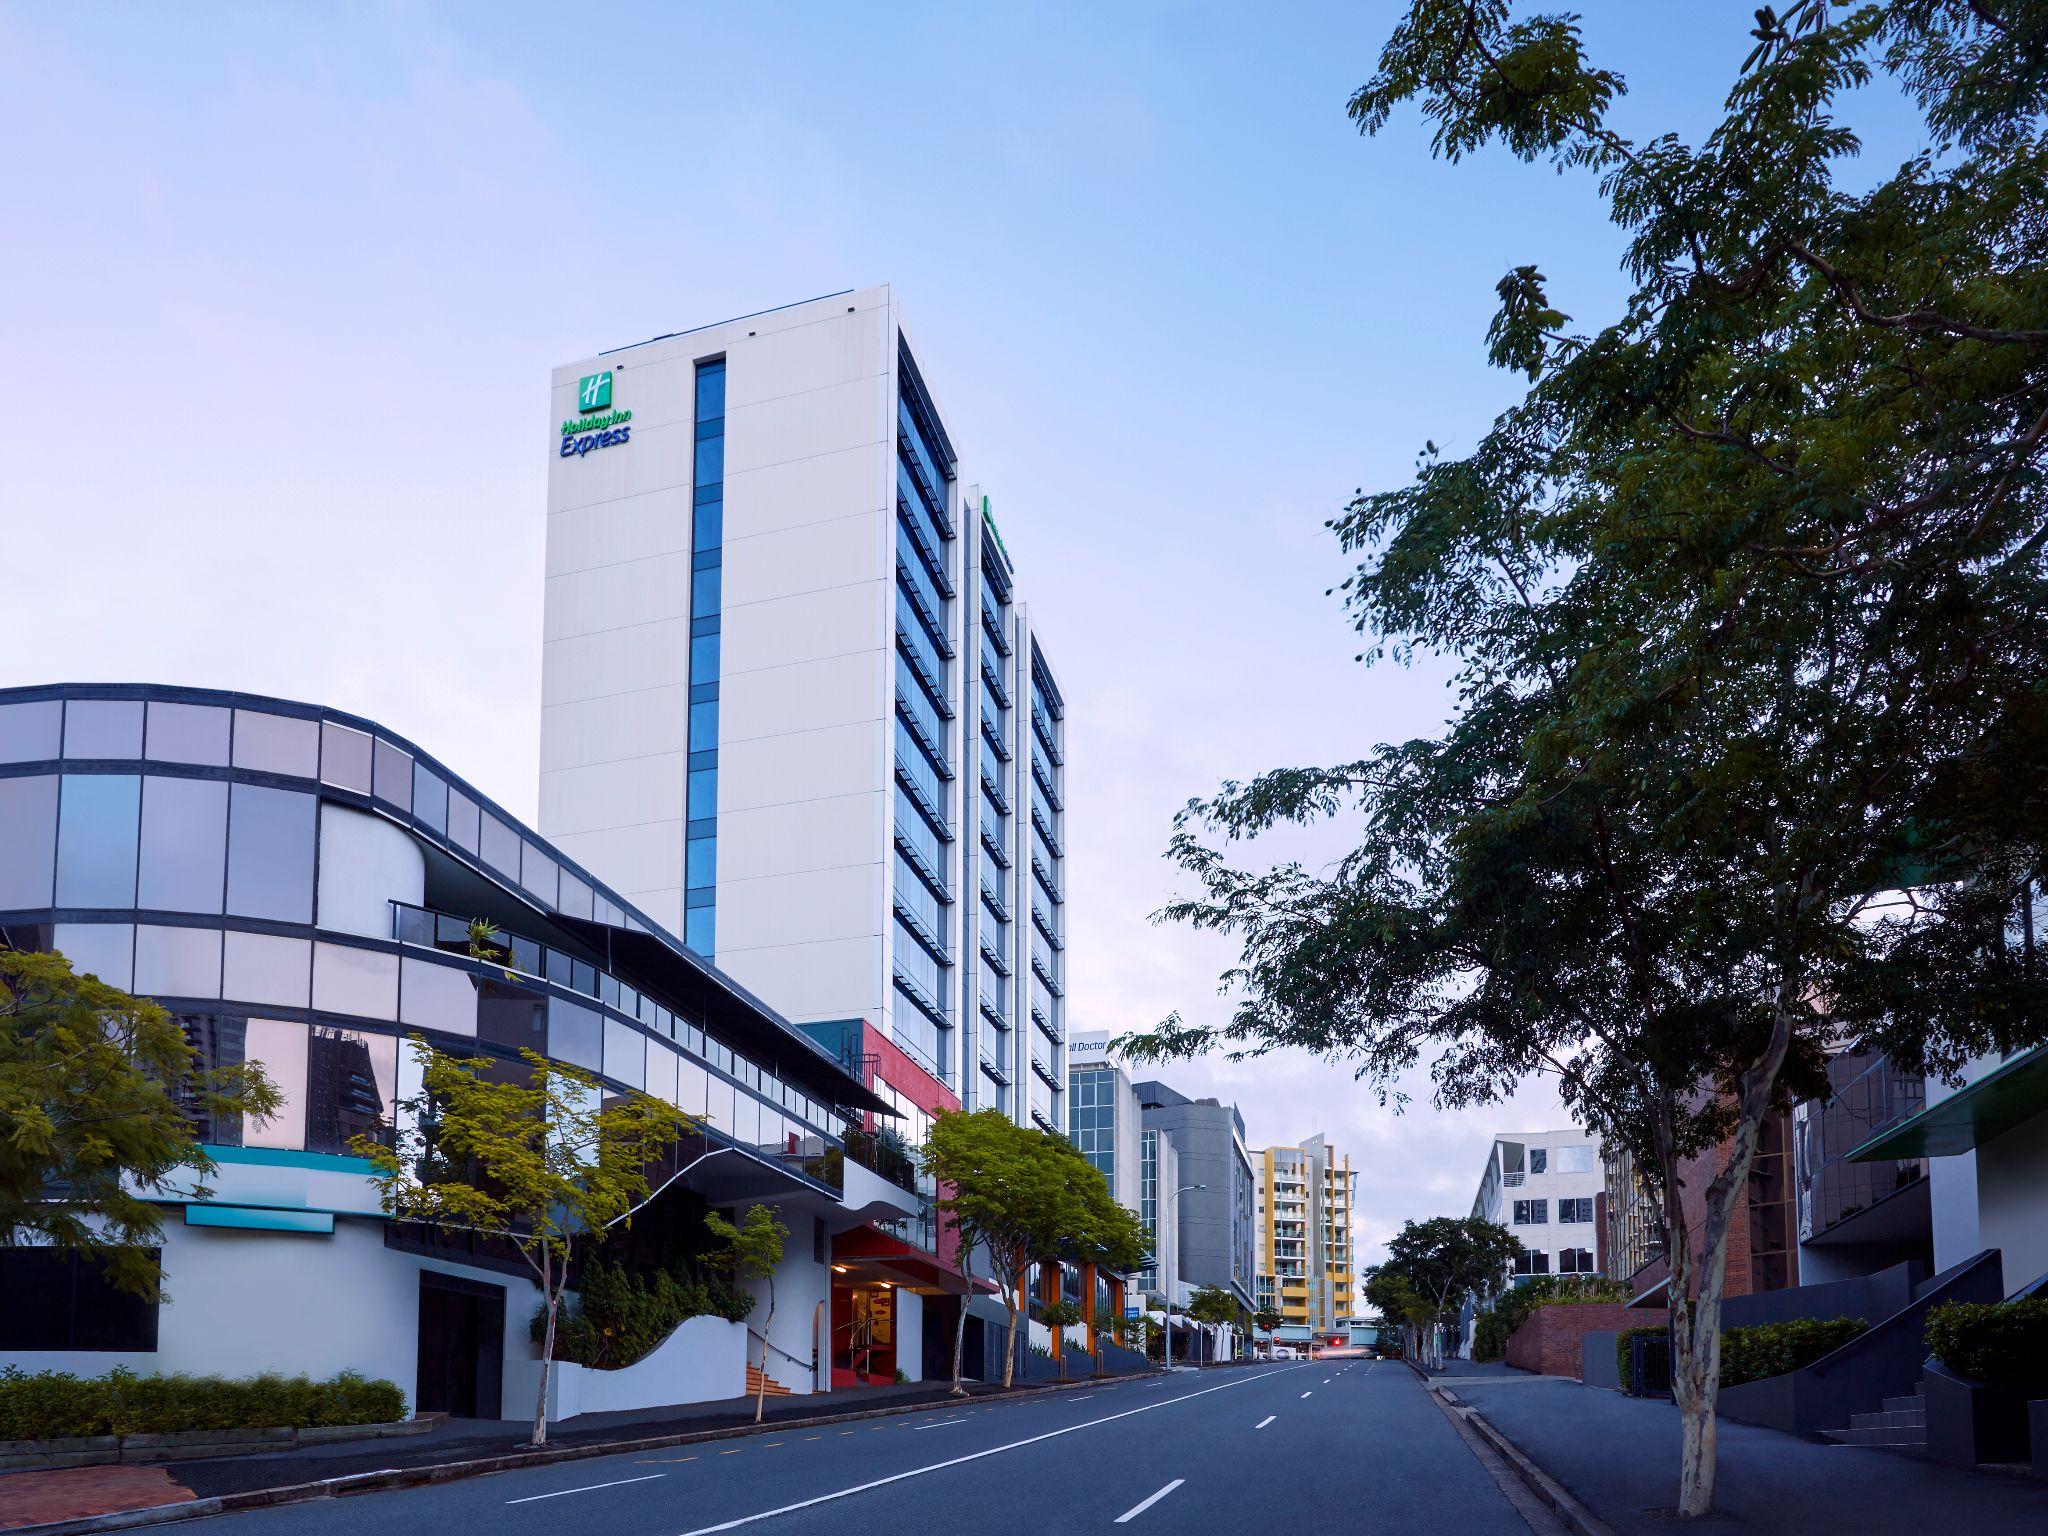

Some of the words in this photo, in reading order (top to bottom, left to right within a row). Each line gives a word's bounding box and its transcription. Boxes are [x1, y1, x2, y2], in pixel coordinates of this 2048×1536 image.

[561, 415, 609, 435] Holiday
[611, 409, 632, 425] Inn
[560, 426, 631, 458] Express
[1078, 1042, 1106, 1051] Doctor
